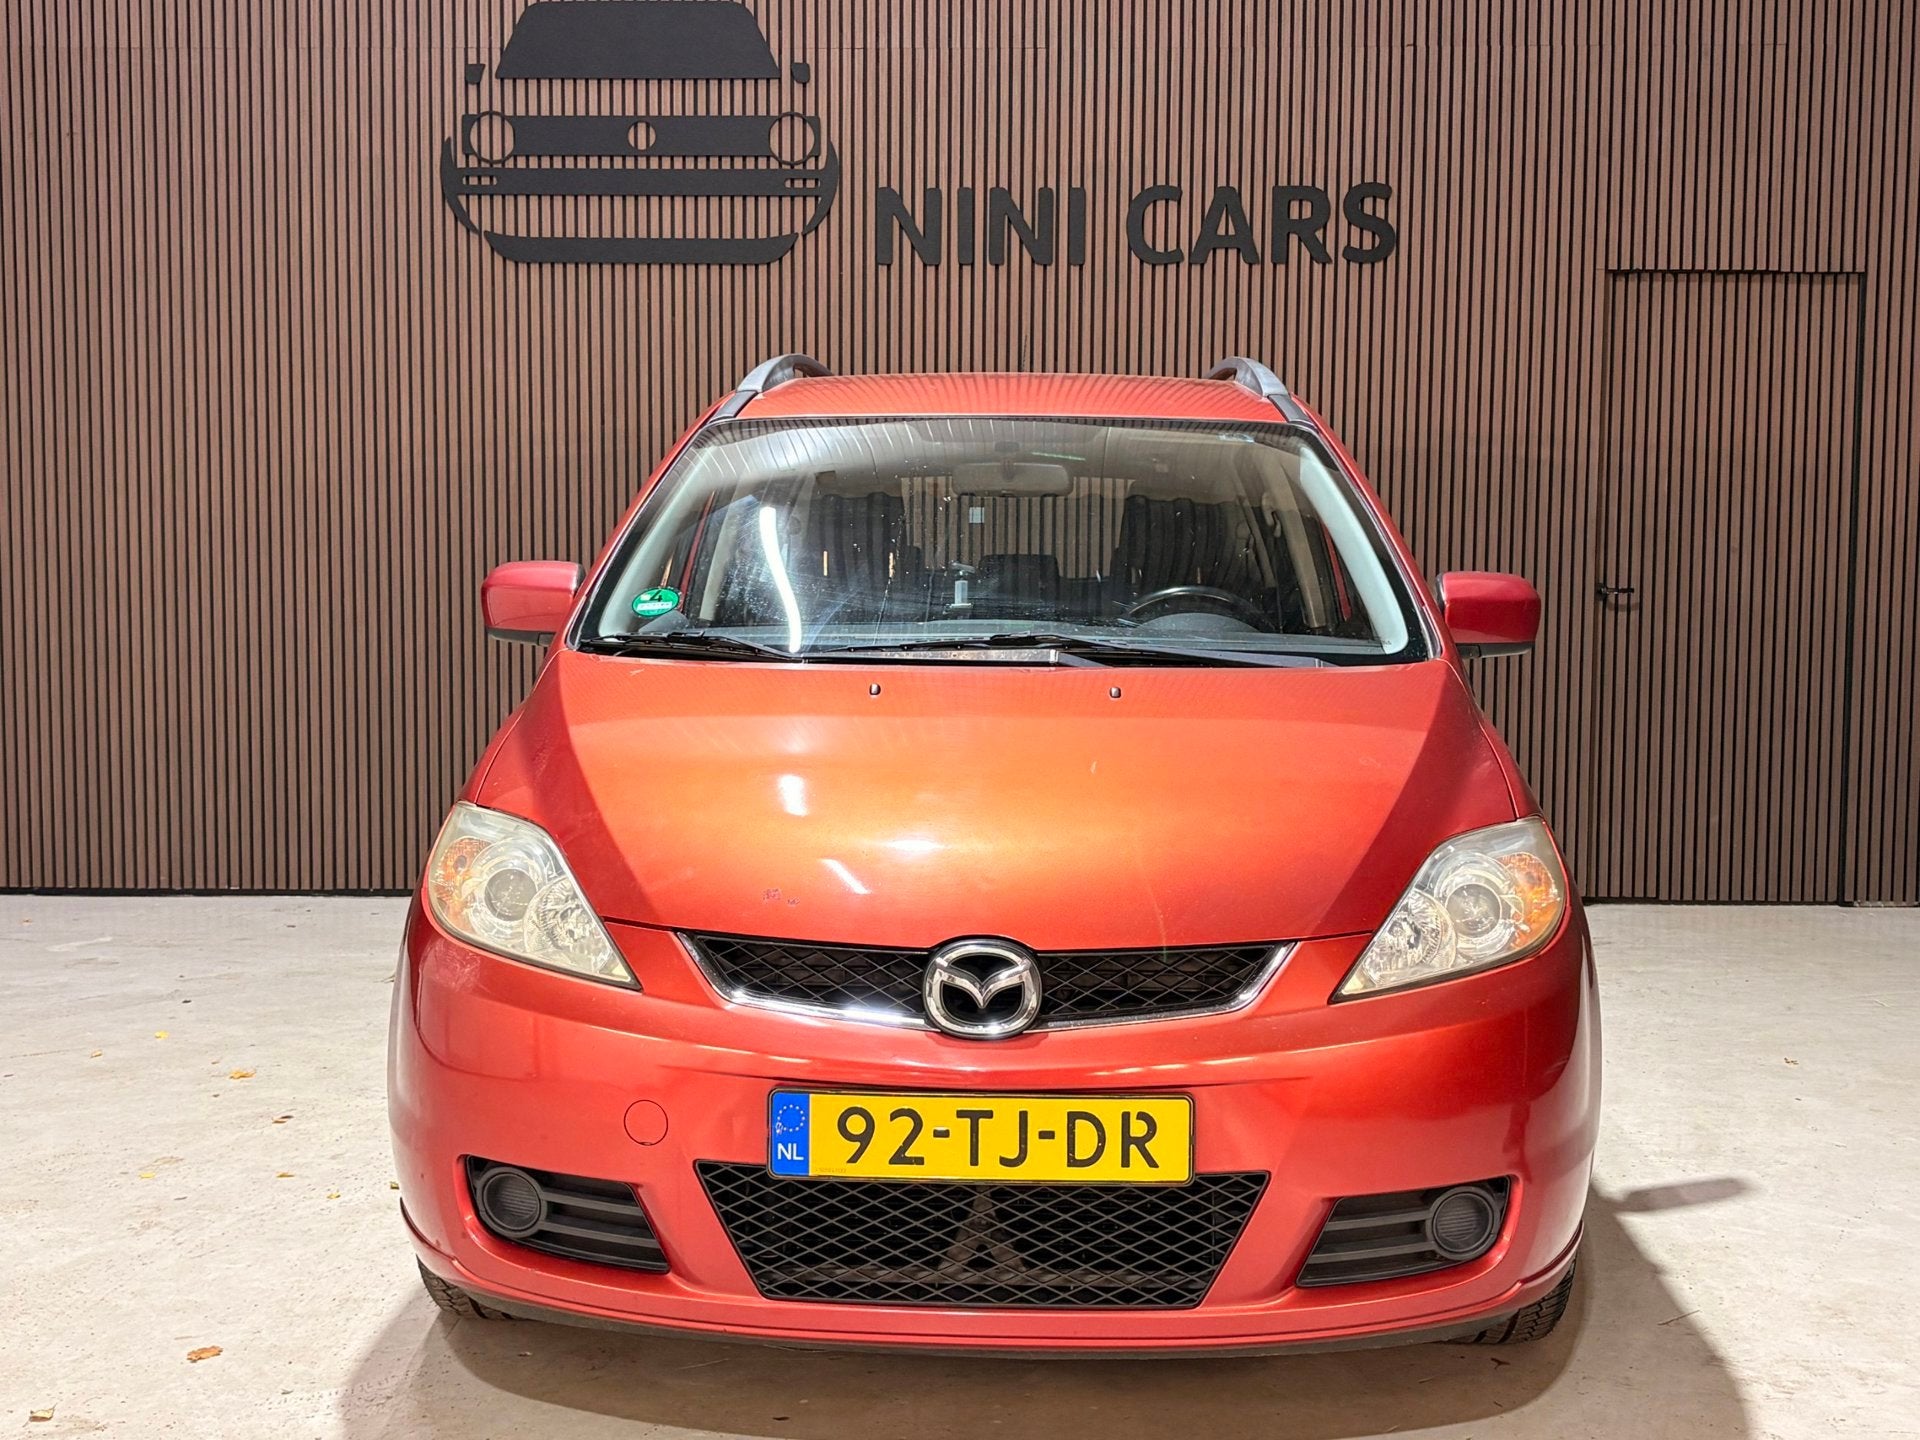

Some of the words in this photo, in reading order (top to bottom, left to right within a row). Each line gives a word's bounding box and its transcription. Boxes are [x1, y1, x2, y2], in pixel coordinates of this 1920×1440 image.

[876, 186, 1086, 266] NINI
[1126, 182, 1397, 265] CARS
[777, 1142, 805, 1161] NL
[837, 1106, 1160, 1169] 92-TJ-DR
